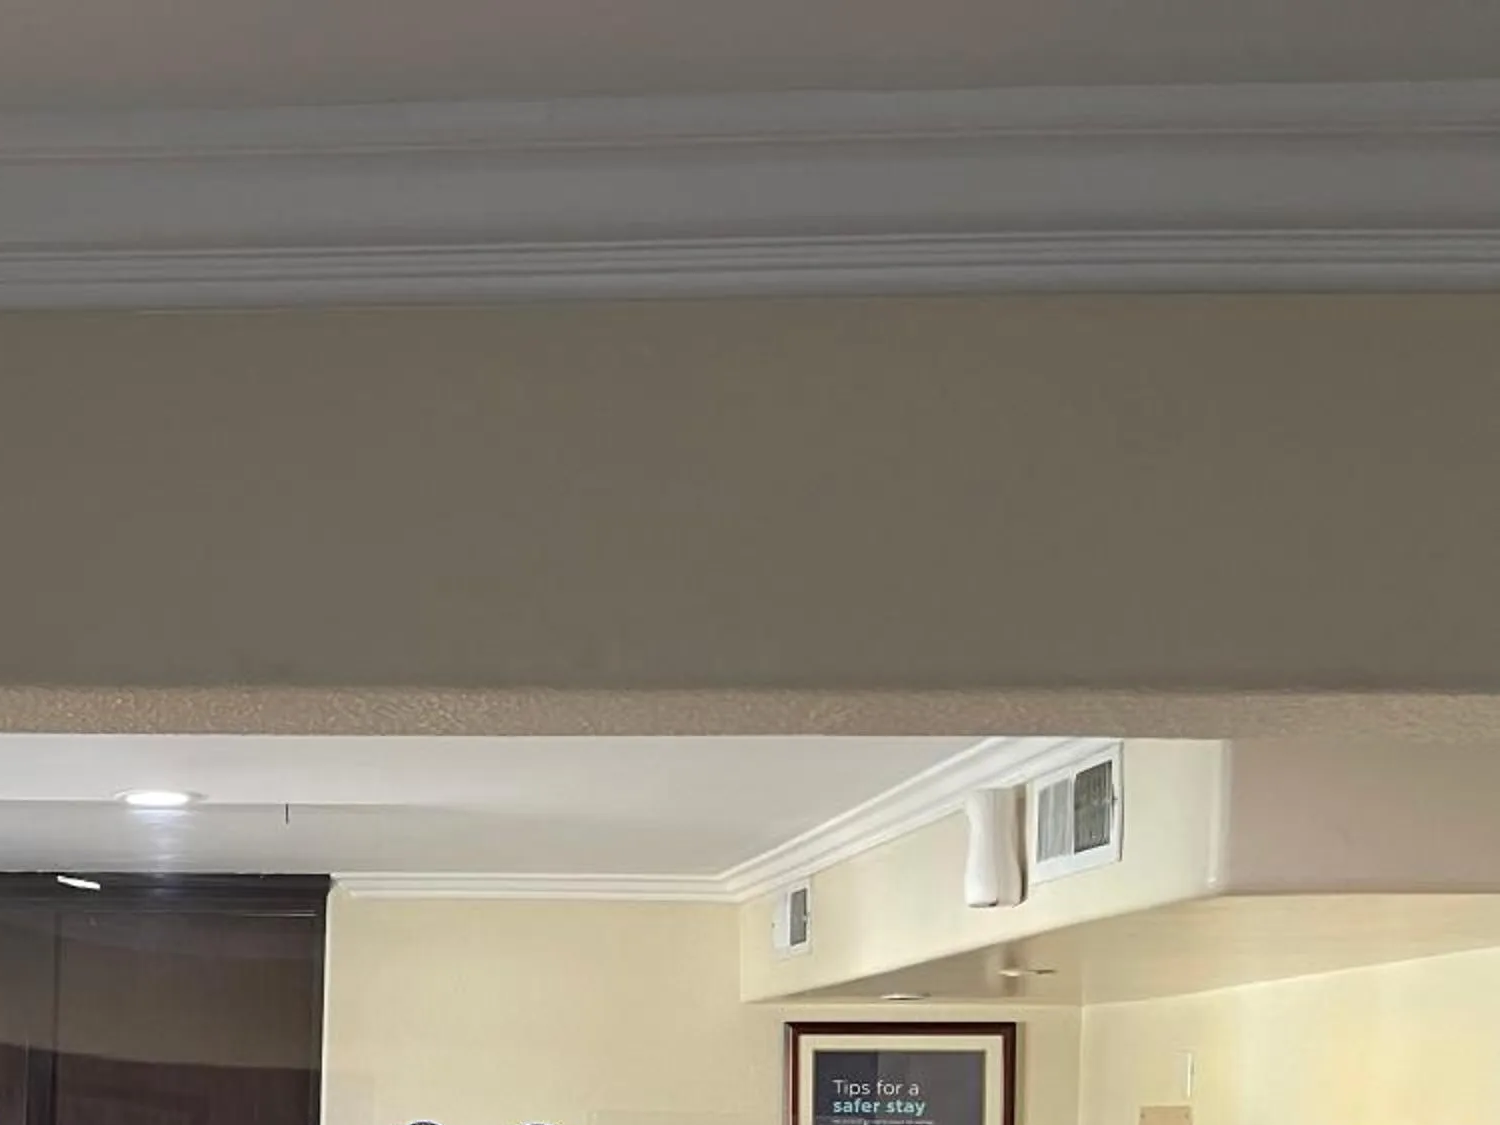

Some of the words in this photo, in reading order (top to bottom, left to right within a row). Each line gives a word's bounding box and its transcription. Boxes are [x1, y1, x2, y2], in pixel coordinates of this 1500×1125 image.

[832, 1079, 871, 1097] Tips
[877, 1079, 903, 1096] for
[908, 1083, 920, 1096] a
[833, 1099, 880, 1113] safer
[886, 1100, 925, 1116] stay
